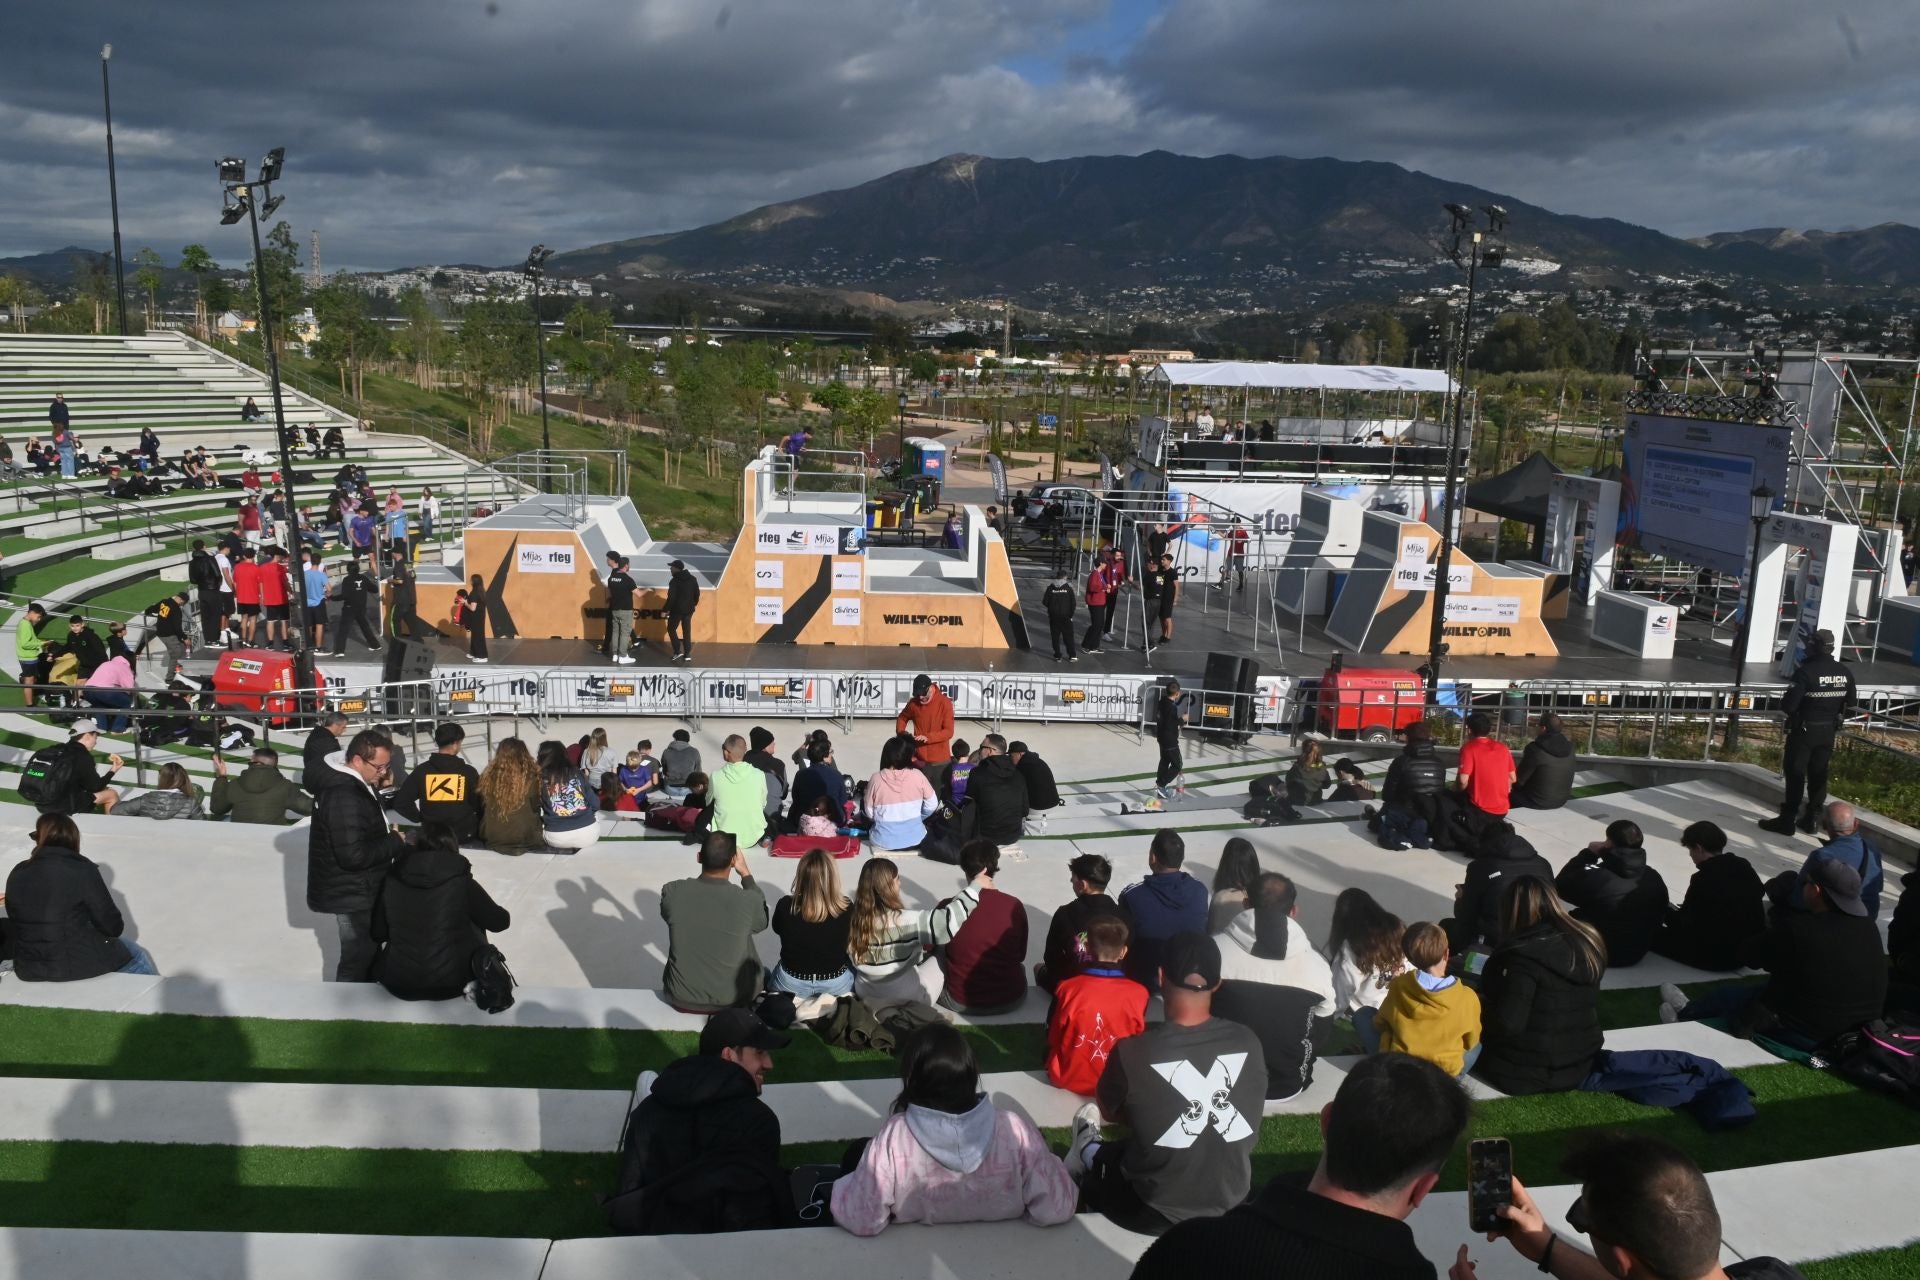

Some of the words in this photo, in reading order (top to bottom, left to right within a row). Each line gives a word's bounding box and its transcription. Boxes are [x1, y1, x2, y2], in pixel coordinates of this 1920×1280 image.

[758, 532, 780, 544] rfeg
[814, 533, 834, 545] Mijas
[1406, 543, 1424, 554] Mijas
[521, 551, 542, 565] Mijas
[549, 551, 571, 563] rfeg
[1398, 569, 1418, 581] rfeg
[834, 606, 859, 614] divina
[884, 614, 963, 626] WALLTOPIA
[439, 671, 486, 694] Mijas
[1819, 675, 1848, 684] POLICIA
[511, 678, 547, 698] rfeg
[612, 685, 632, 693] AMG
[640, 674, 686, 701] Mijas
[710, 681, 746, 700] rfeg
[763, 685, 784, 693] AMG
[836, 676, 882, 702] Mijas
[452, 692, 473, 701] AMG
[1088, 692, 1143, 705] Iberdrola
[341, 702, 363, 711] AMG
[1208, 706, 1228, 714] AMG
